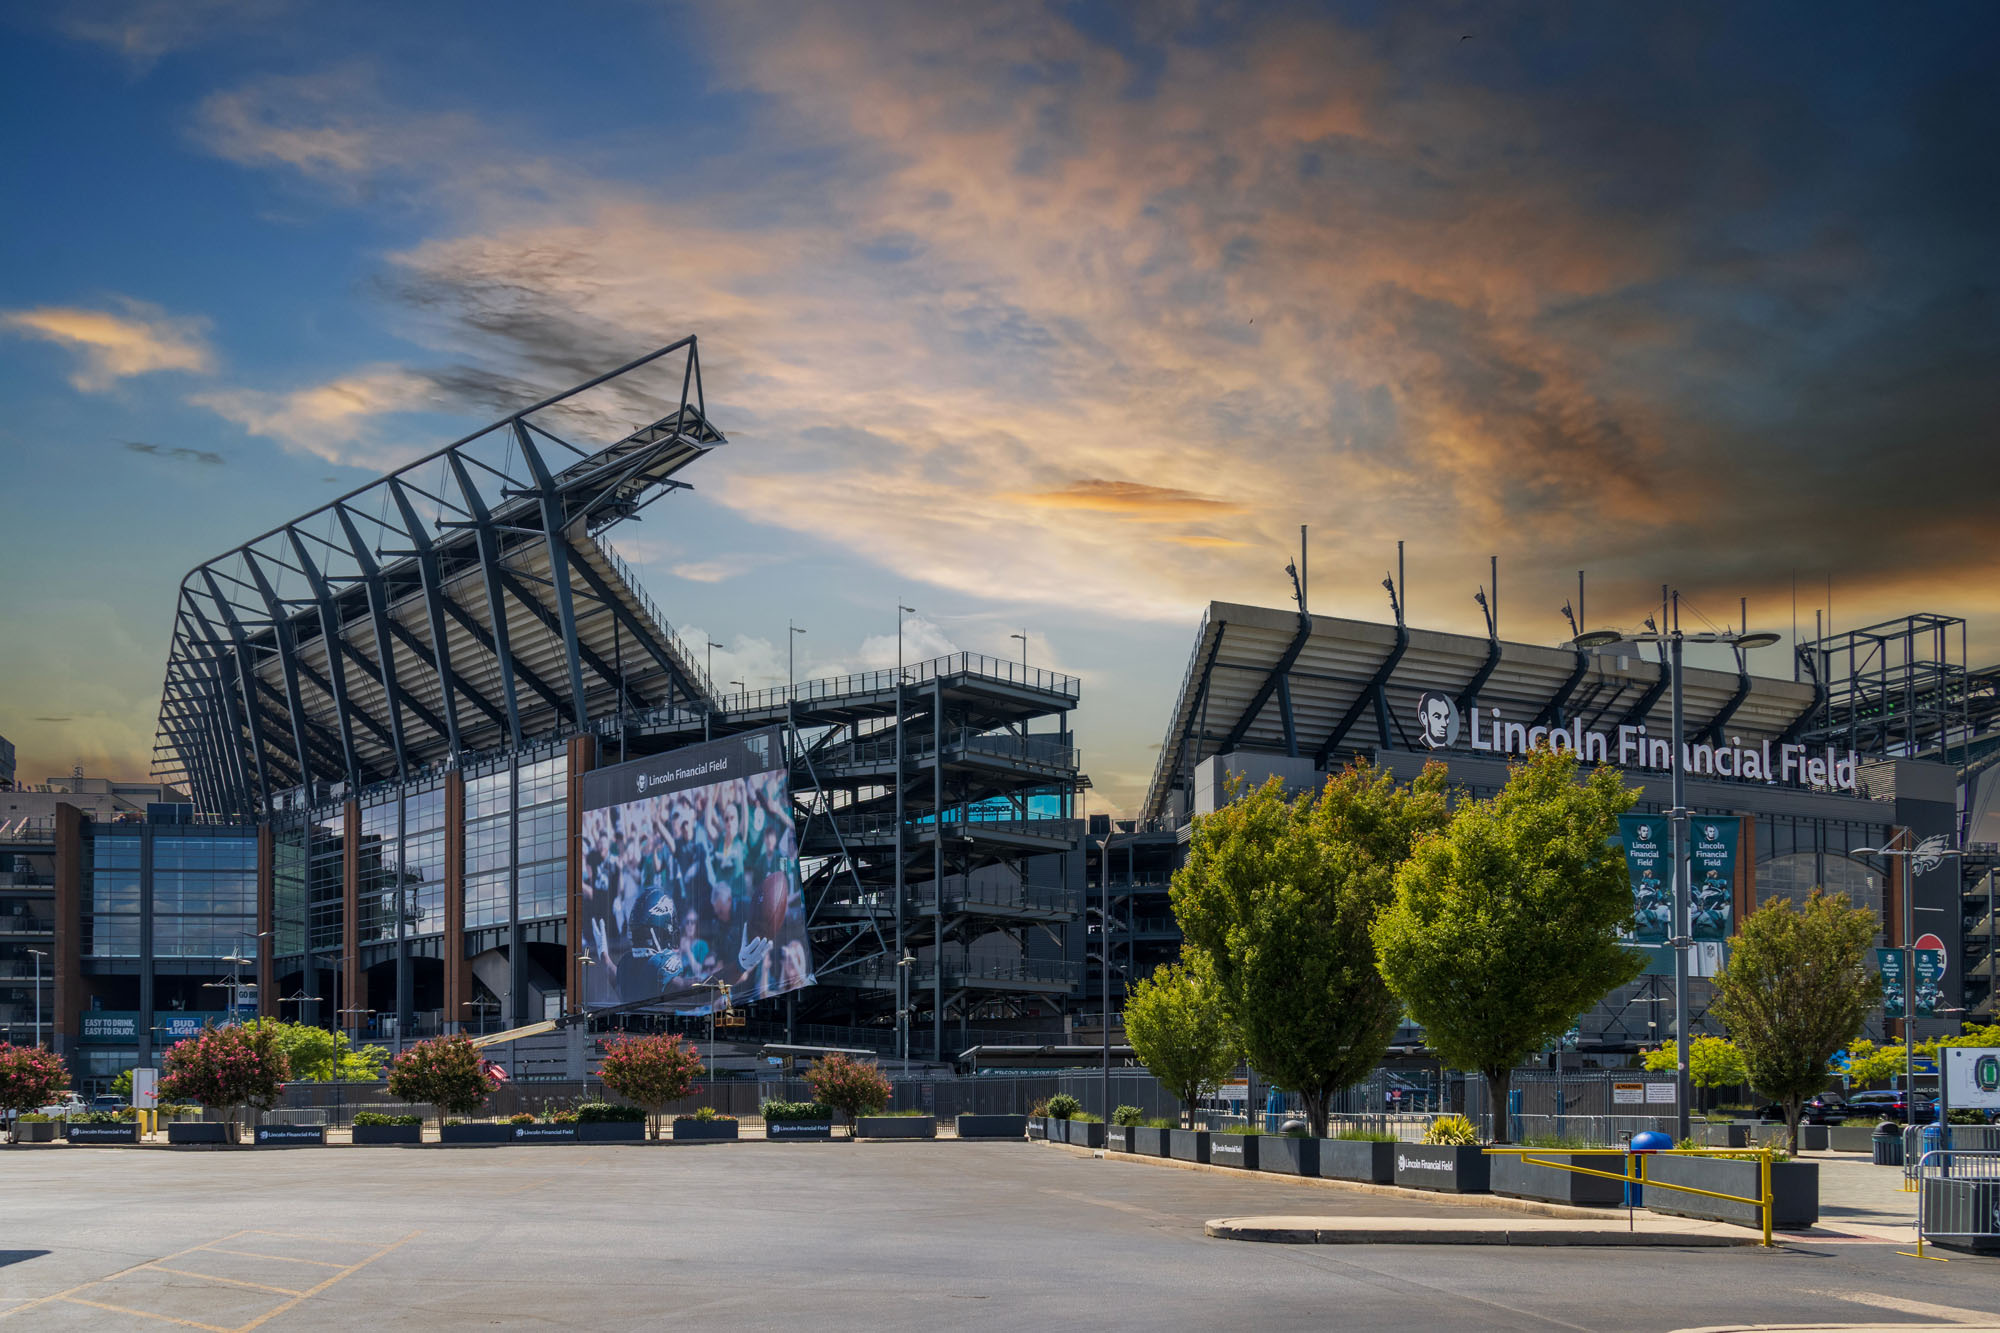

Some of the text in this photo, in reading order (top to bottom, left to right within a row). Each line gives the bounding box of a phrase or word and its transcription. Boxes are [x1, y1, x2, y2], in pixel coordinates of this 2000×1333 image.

[1471, 707, 1607, 762] Lincoln
[1781, 743, 1857, 789] Field
[649, 757, 728, 786] Lincoln Financial Field
[1630, 850, 1659, 858] Financial
[1696, 850, 1728, 858] Financial
[85, 1019, 135, 1028] EASY TO DRINK,
[173, 1019, 195, 1027] BUD
[85, 1027, 136, 1035] EASY TO ENJOY.
[168, 1027, 199, 1035] LIGHT
[1405, 1158, 1453, 1171] Lincoln Financial Field
